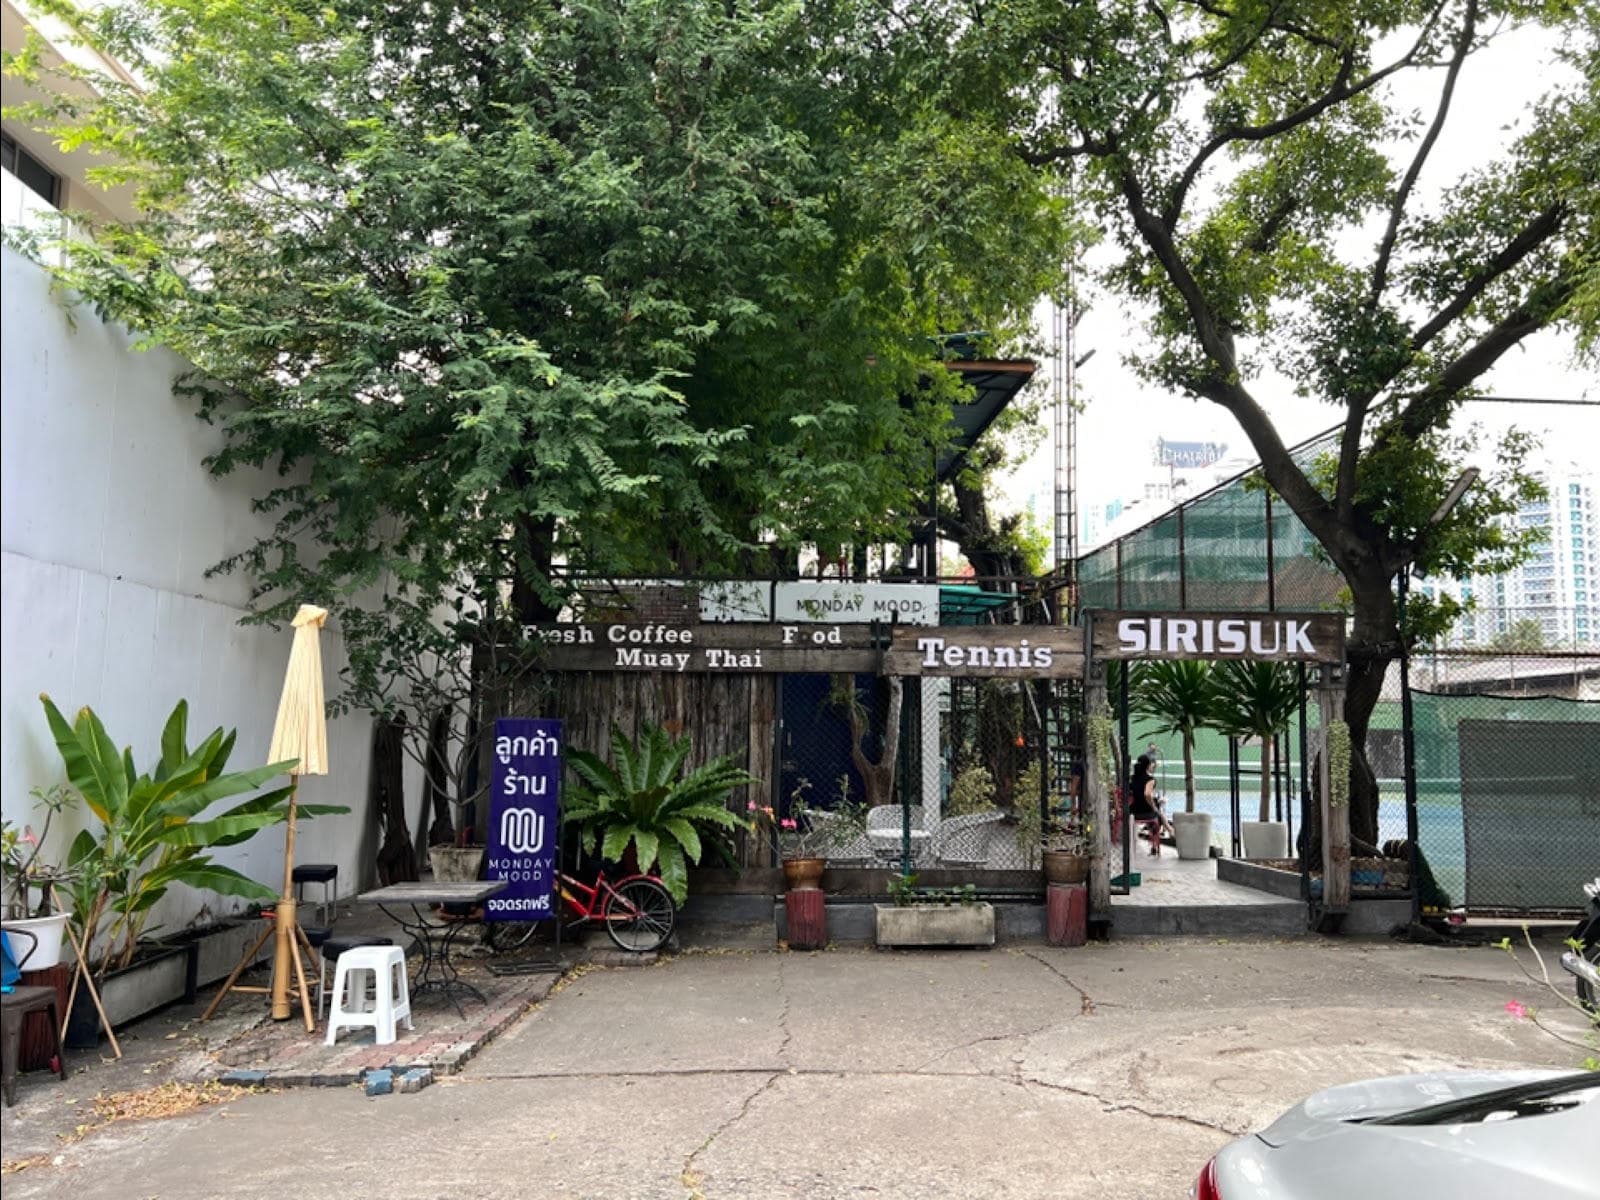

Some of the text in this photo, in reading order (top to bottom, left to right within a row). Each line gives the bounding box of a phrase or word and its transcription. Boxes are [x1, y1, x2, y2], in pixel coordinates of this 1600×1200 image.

[796, 599, 863, 613] MONDAY
[607, 624, 693, 644] Coffee
[1118, 618, 1316, 655] SIRISUK
[615, 648, 763, 671] Muay Thai
[918, 638, 1053, 669] Tennis
[495, 729, 558, 764] ลูกค้า
[503, 767, 547, 795] ร้าน
[488, 858, 553, 869] MONDAY
[498, 871, 542, 882] MOOD
[488, 894, 550, 911] จอดรถฟรี
